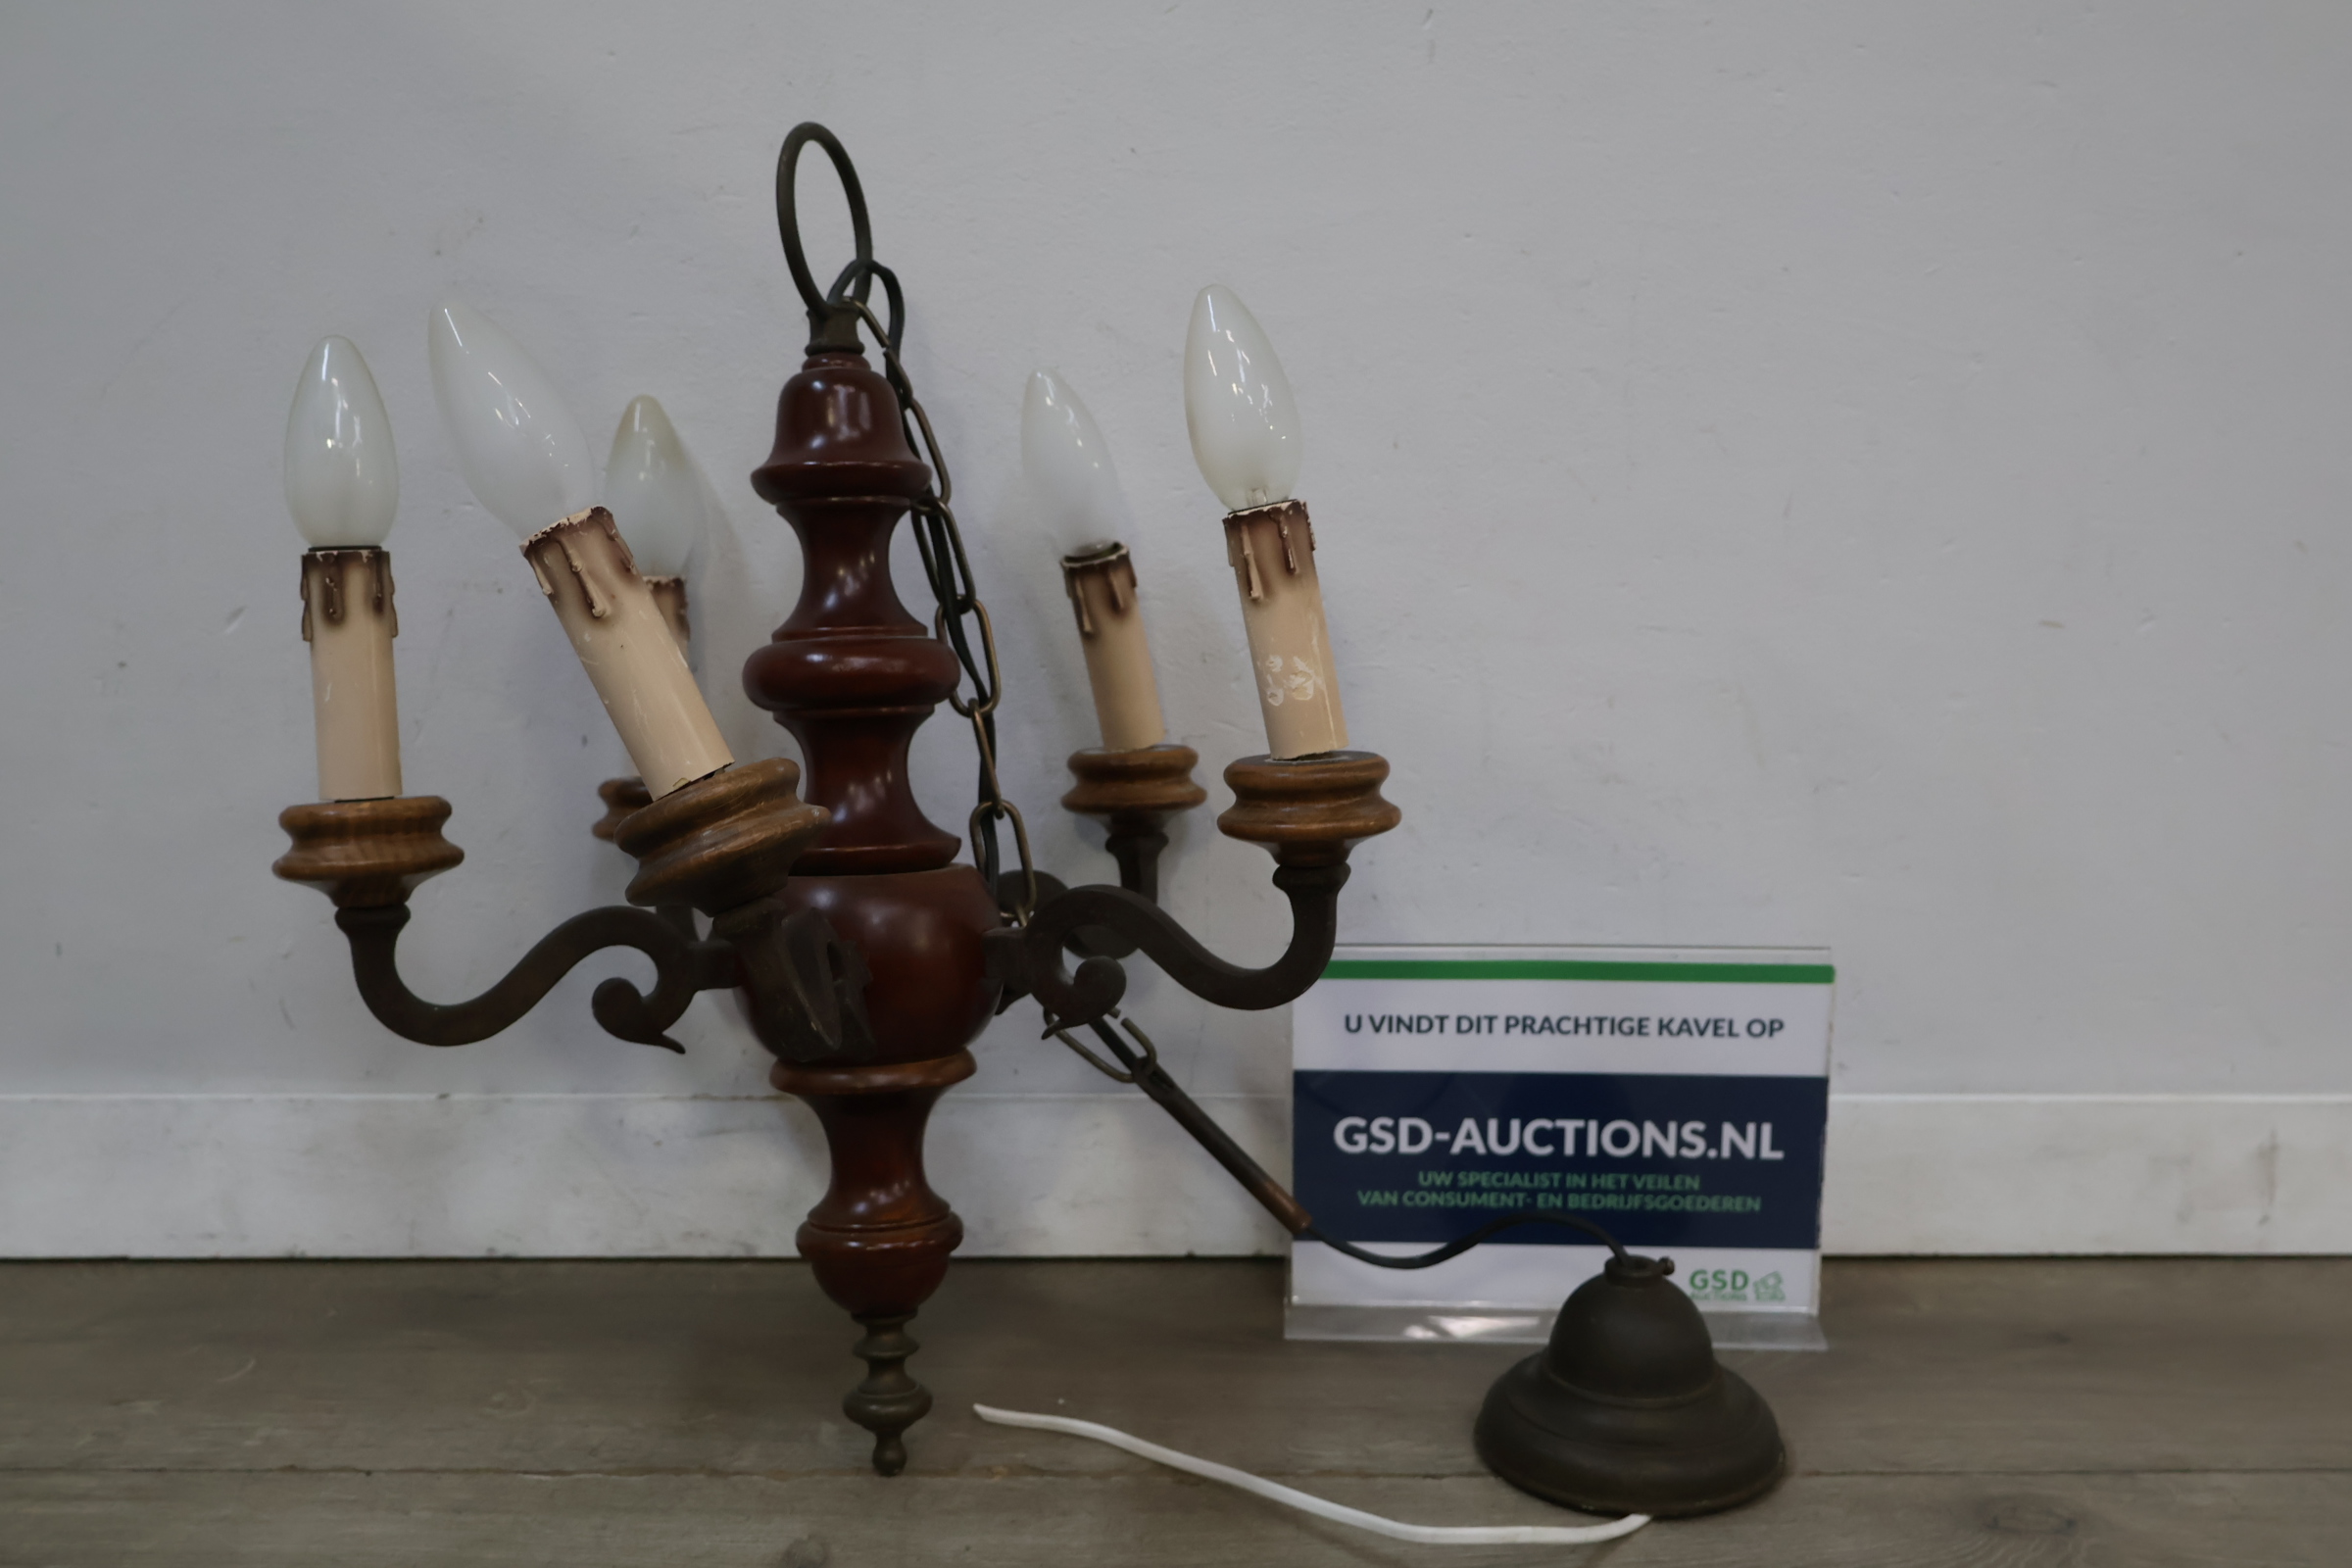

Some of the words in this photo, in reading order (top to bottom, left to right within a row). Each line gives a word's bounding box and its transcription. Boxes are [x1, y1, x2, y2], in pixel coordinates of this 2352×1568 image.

[1345, 1014, 1362, 1033] U
[1368, 1014, 1449, 1035] VINDT
[1456, 1015, 1497, 1035] DIT
[1504, 1015, 1650, 1036] PRACHTIGE
[1658, 1017, 1740, 1037] KAVEL
[1746, 1018, 1784, 1038] OP
[1334, 1116, 1784, 1159] GSD-AUCTIONS.NL
[1419, 1171, 1453, 1187] UW
[1457, 1171, 1561, 1188] SPECIALIST
[1566, 1173, 1587, 1189] IN
[1592, 1173, 1628, 1190] HET
[1632, 1174, 1700, 1191] VEILEN
[1357, 1190, 1398, 1206] VAN
[1402, 1190, 1533, 1208] CONSUMENT-
[1537, 1192, 1562, 1208] EN
[1568, 1193, 1761, 1212] BEDRIJFSGOEDEREN
[1690, 1270, 1748, 1291] GSD
